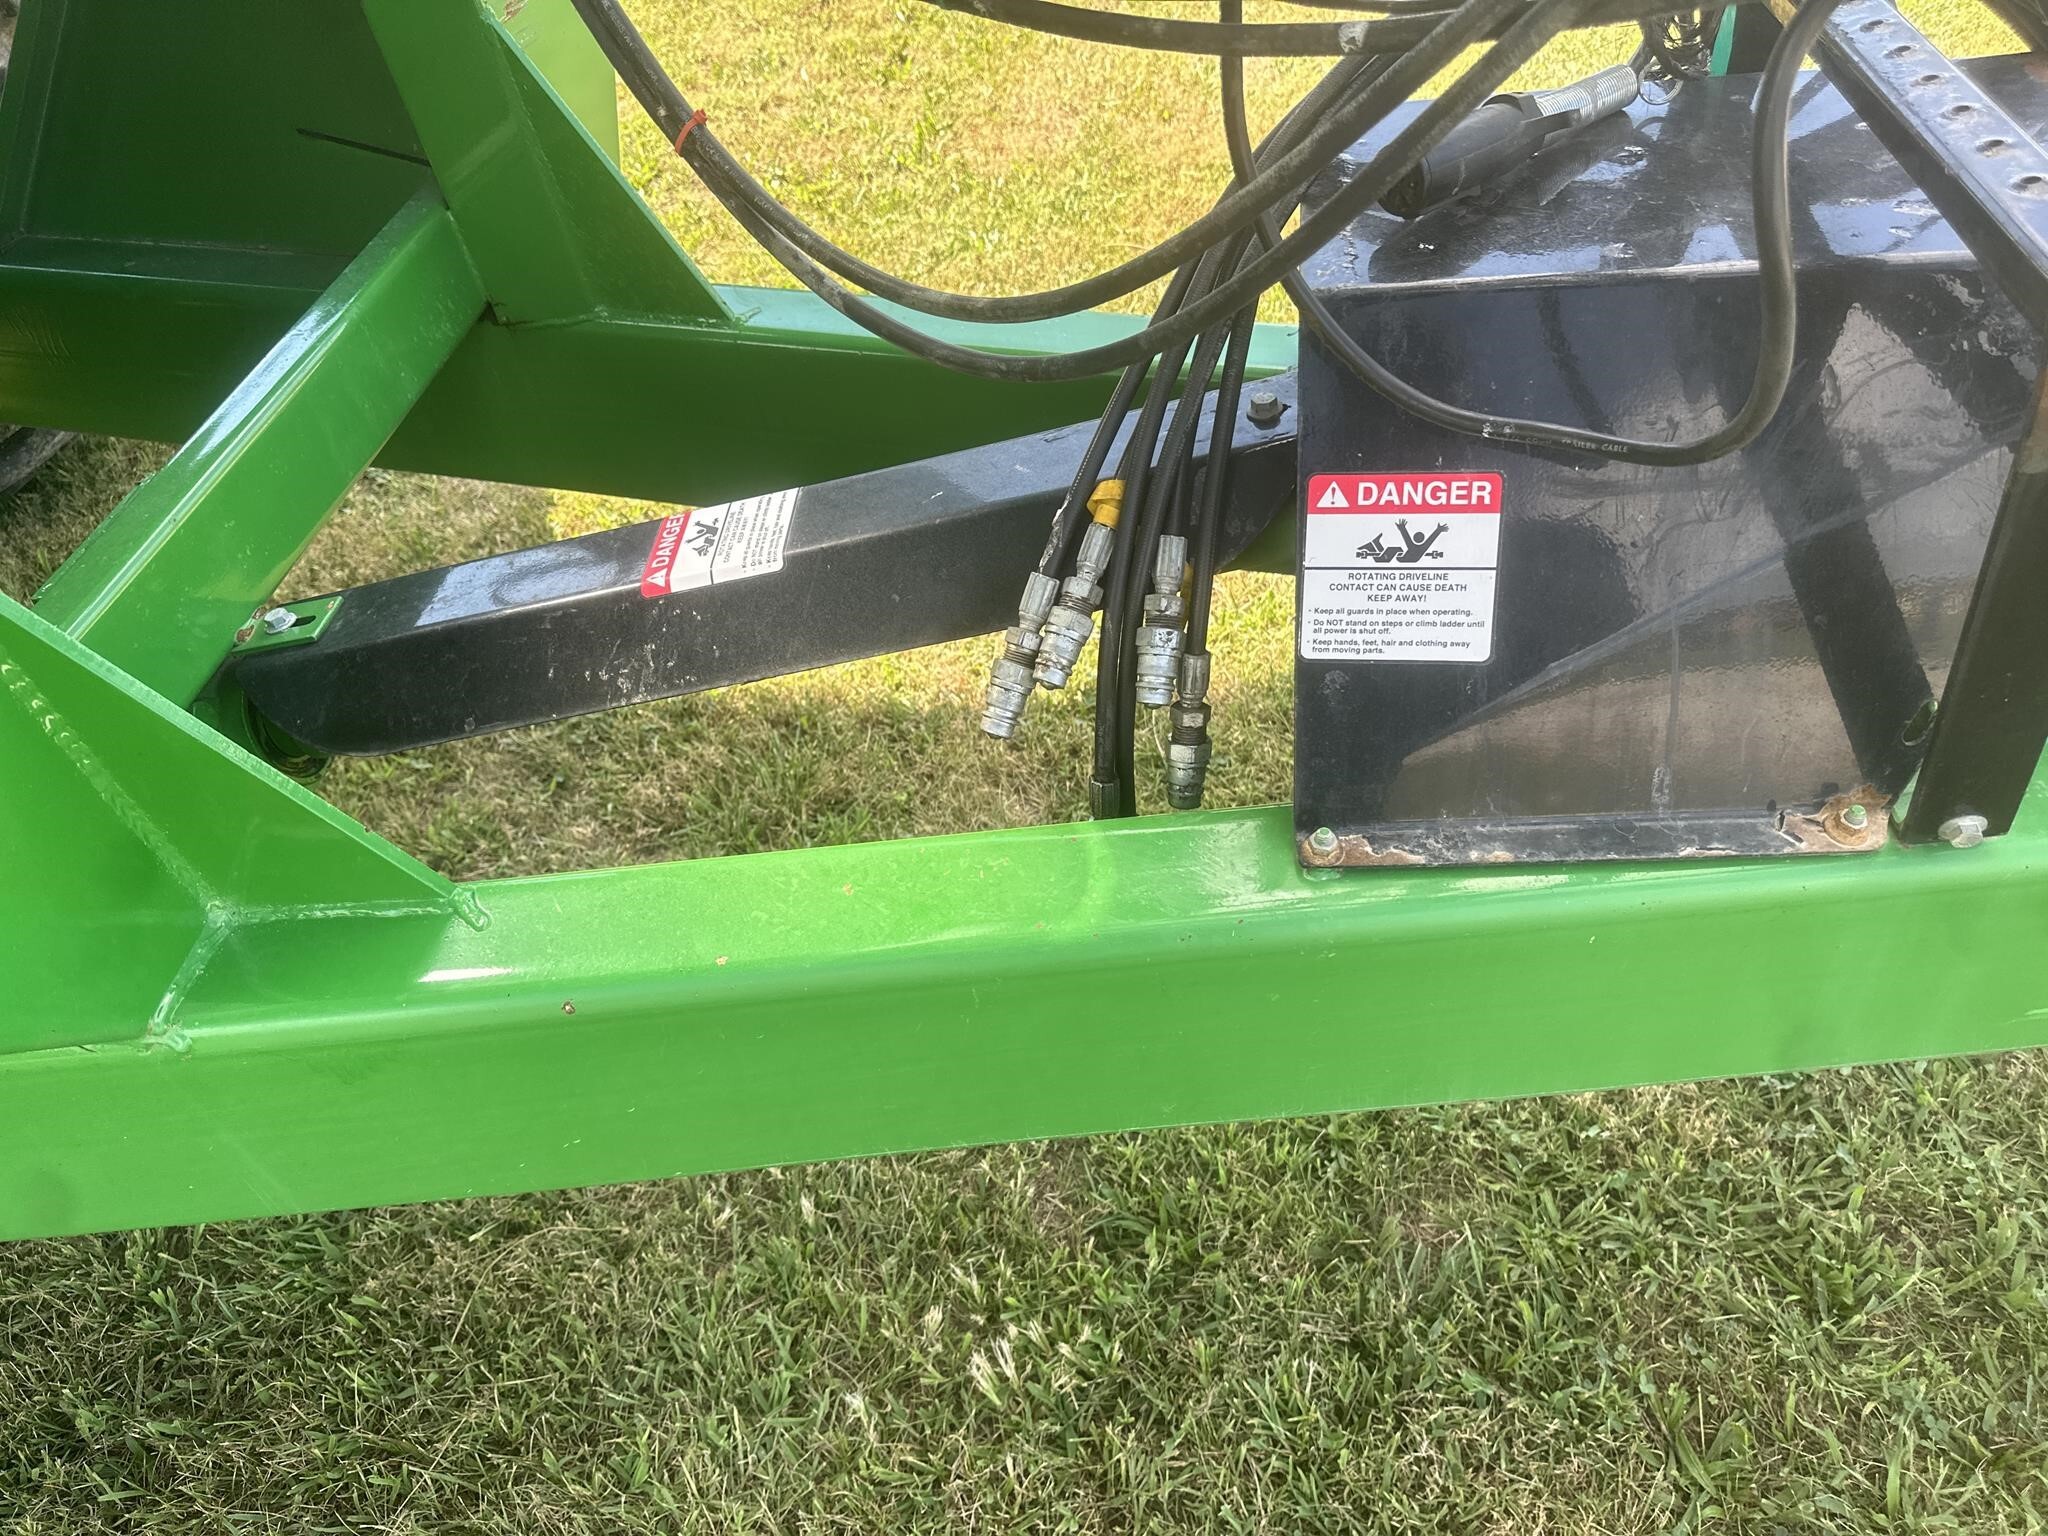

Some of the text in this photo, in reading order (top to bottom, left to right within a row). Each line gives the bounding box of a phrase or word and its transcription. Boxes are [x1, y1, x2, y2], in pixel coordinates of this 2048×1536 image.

[1357, 481, 1492, 506] DANGER
[1348, 572, 1449, 581] ROTATING DRIVELINE
[1329, 583, 1467, 592] CONTACT CAN CAUSE DEATH
[1367, 594, 1427, 602] KEEP AWAY!
[1313, 607, 1334, 617] Keep
[1346, 607, 1374, 617] guards
[1385, 607, 1408, 617] place
[1432, 607, 1473, 617] operating.
[1381, 619, 1403, 628] steps
[1324, 628, 1348, 636] power
[1312, 638, 1471, 648] Keep hands, feet, hair and clothing away
[1331, 646, 1361, 655] moving
[1362, 646, 1385, 655] parts.
